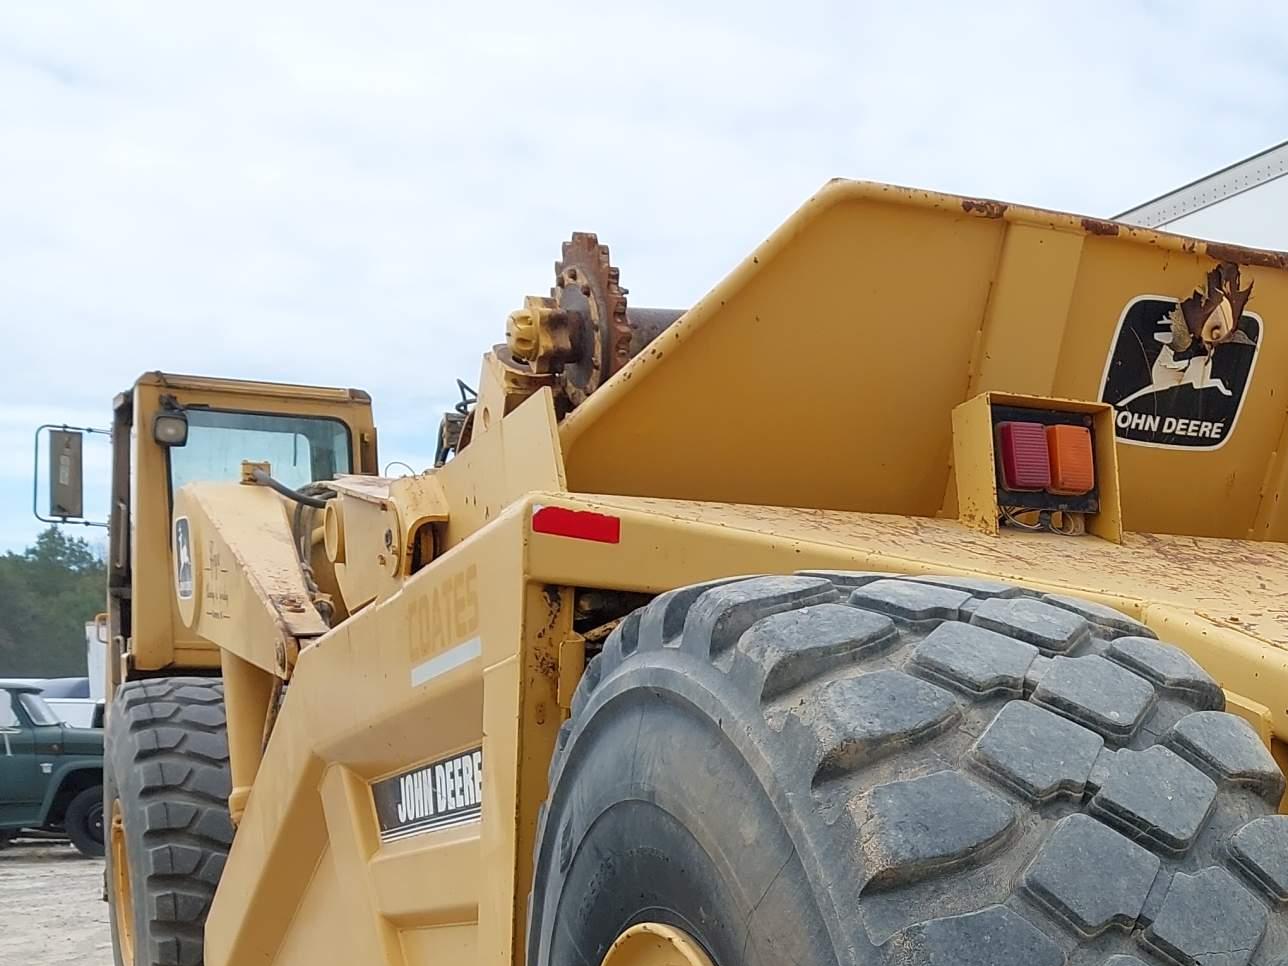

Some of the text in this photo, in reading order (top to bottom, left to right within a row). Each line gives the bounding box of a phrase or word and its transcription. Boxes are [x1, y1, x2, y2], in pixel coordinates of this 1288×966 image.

[1114, 410, 1224, 439] OHN DEERE
[408, 564, 479, 663] COATES
[398, 751, 482, 823] JOHN DEERE
